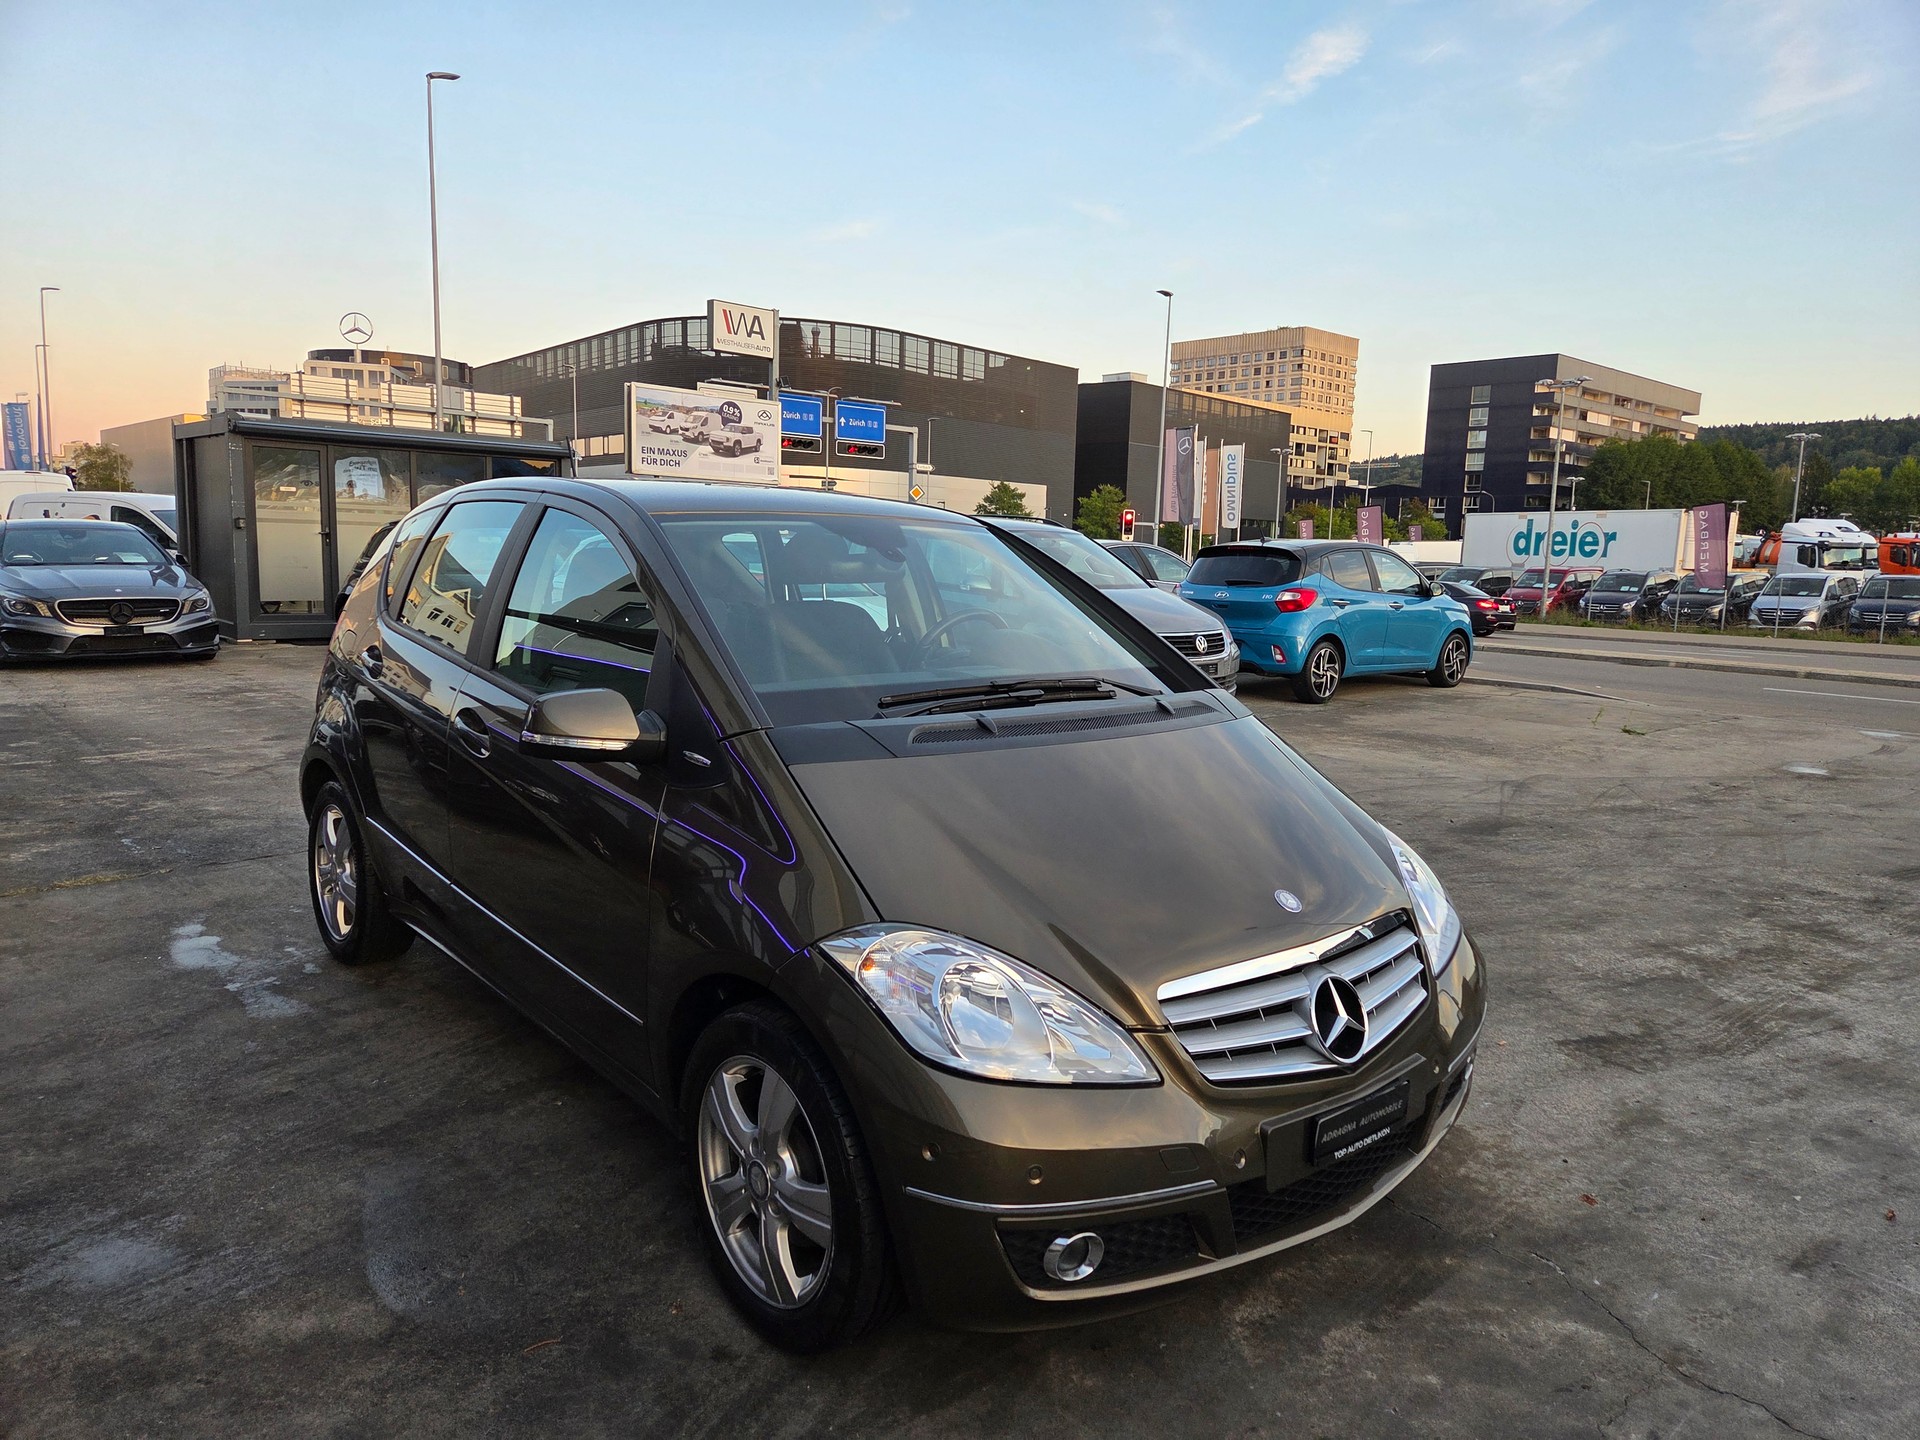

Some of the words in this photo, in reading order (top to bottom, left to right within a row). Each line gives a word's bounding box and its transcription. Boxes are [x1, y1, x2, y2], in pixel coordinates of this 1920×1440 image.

[782, 410, 801, 420] Zürich
[848, 418, 866, 427] Zürich
[641, 446, 656, 456] EIN
[657, 447, 688, 458] MAXUS
[641, 455, 658, 466] FÜR
[660, 459, 681, 468] DICH
[1513, 519, 1617, 558] dreier
[1334, 1148, 1347, 1160] TOP
[1347, 1140, 1363, 1154] AUTO
